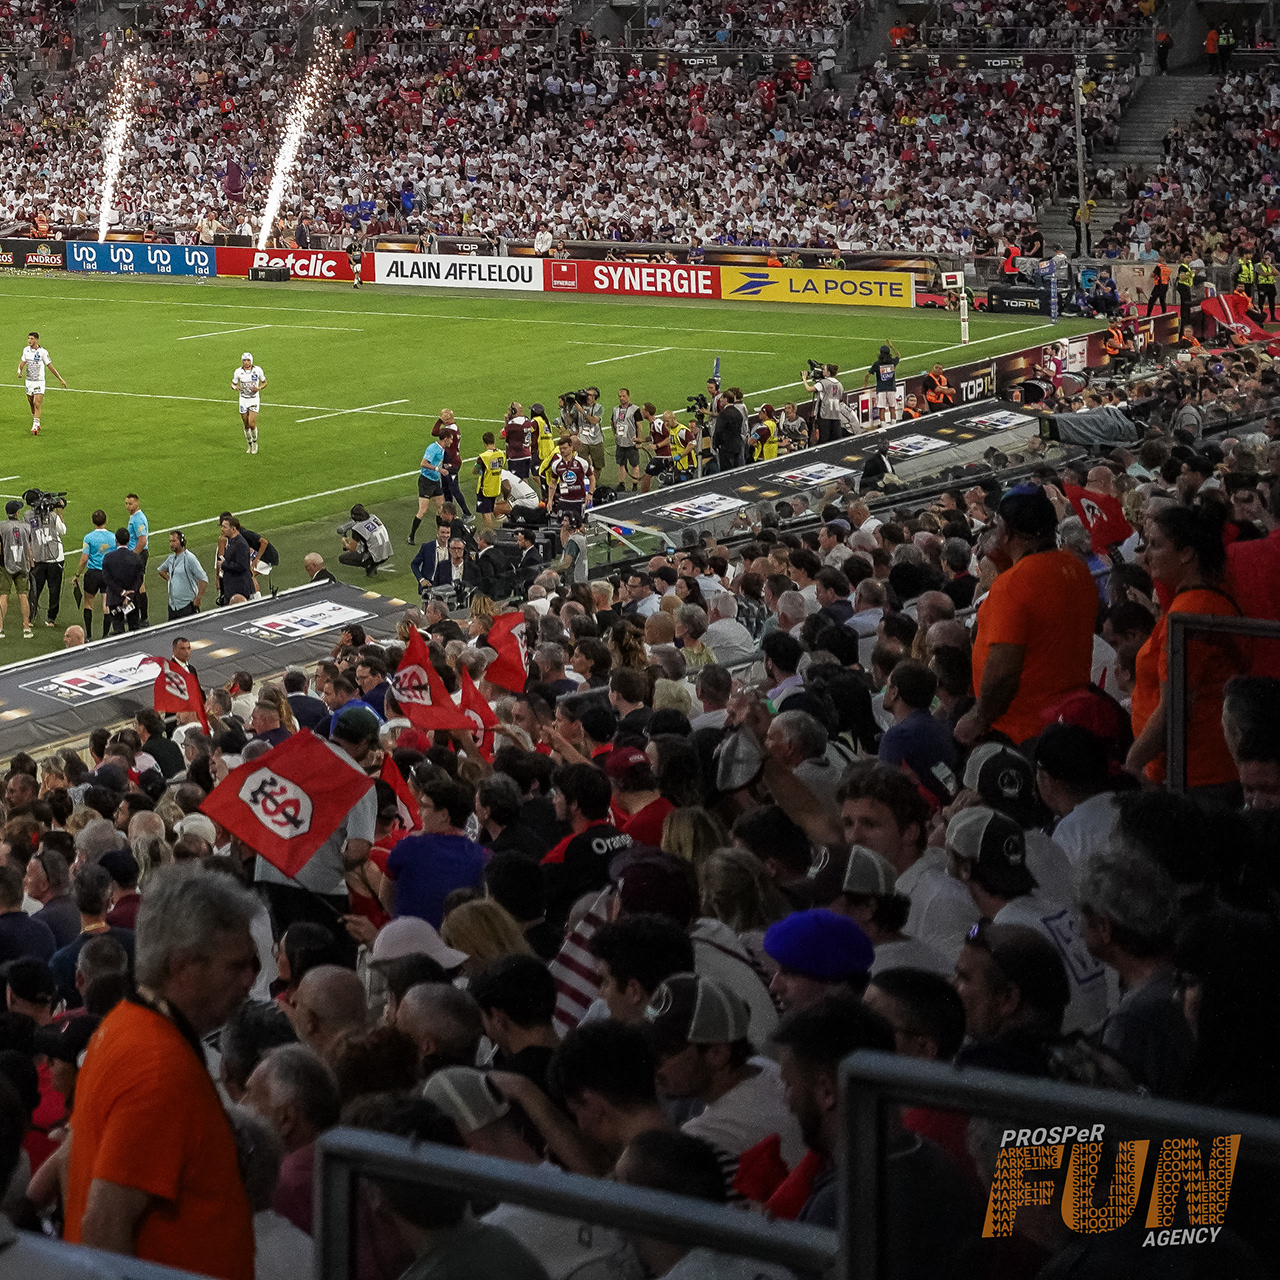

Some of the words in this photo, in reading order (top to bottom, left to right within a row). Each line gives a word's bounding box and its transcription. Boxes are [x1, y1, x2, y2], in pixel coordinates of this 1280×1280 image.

[455, 243, 479, 251] TOP
[27, 254, 63, 265] ANDROS
[83, 260, 97, 270] iad
[120, 261, 134, 271] iad
[157, 263, 171, 273] iad
[195, 264, 209, 274] iad
[386, 260, 440, 279] ALAIN
[444, 263, 533, 284] AFFLELOU
[593, 265, 713, 295] SYNERGIE
[789, 277, 819, 294] LA
[825, 279, 904, 298] POSTE
